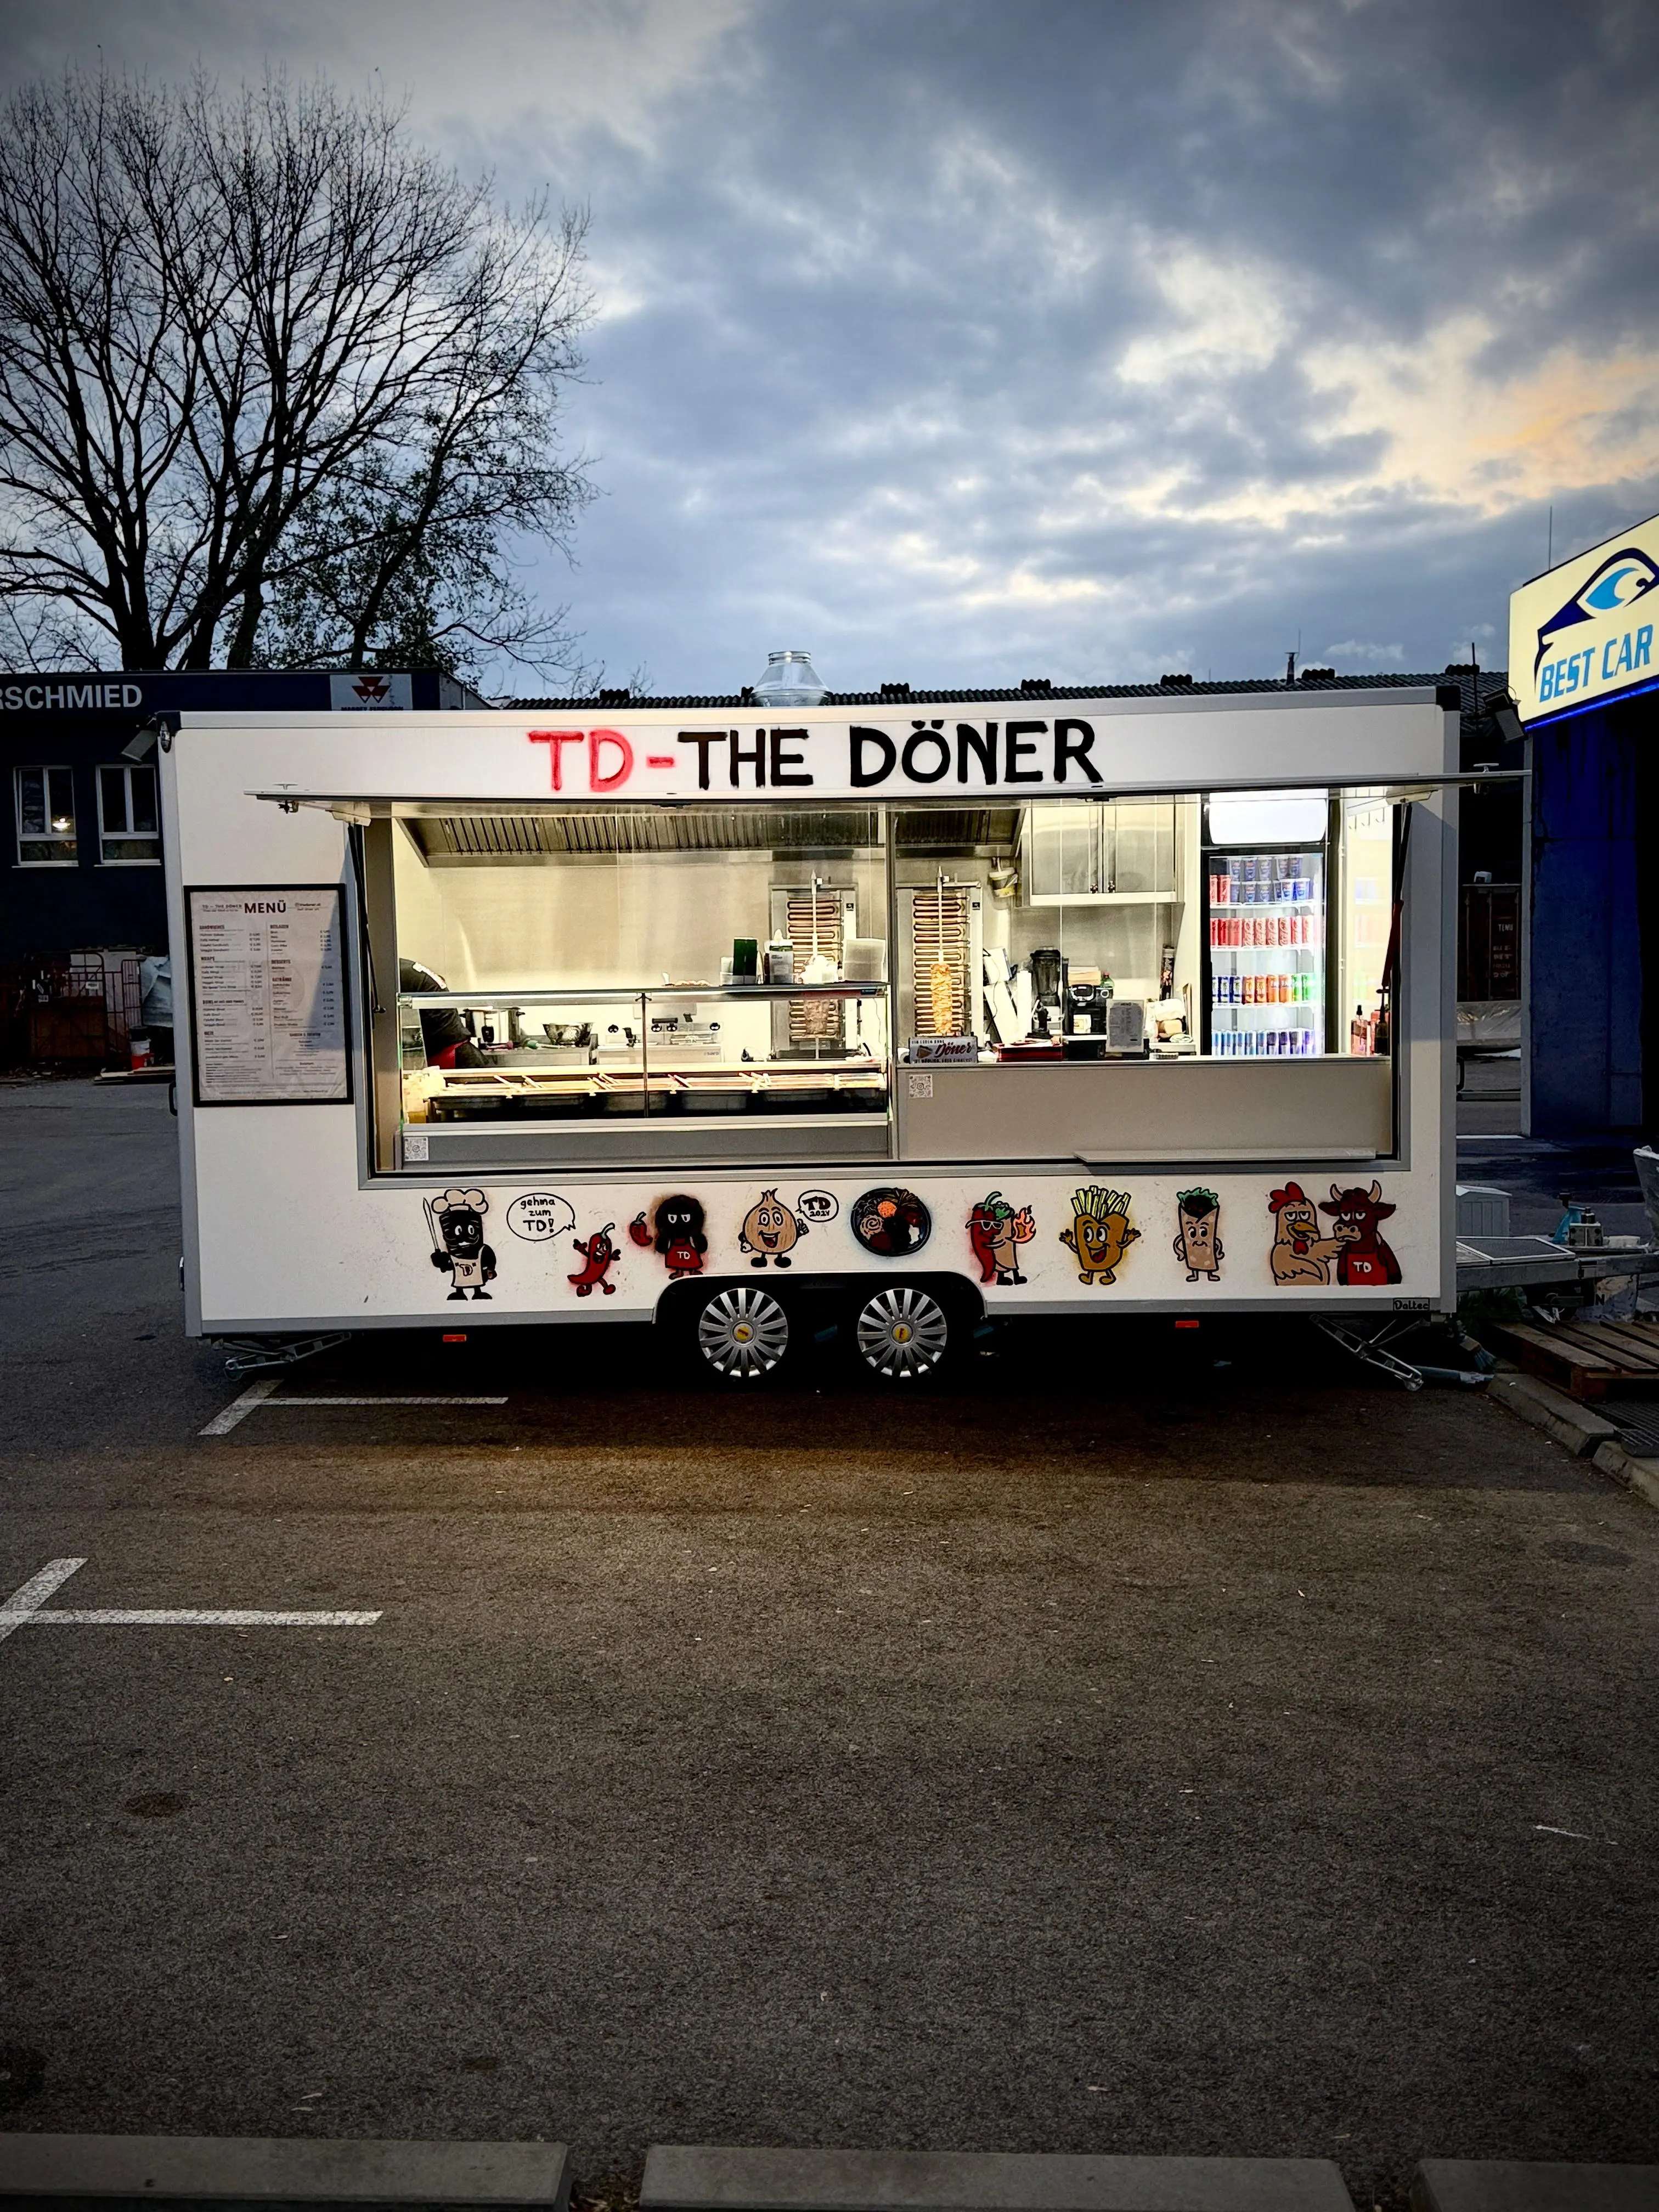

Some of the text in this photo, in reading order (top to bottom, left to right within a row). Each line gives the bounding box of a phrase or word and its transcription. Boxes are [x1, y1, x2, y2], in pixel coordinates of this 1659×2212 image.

[1539, 624, 1654, 703] BEST CAR
[0, 685, 143, 710] SCHMIED
[849, 719, 1103, 787] DÖNER
[244, 900, 286, 913] MENÜ
[521, 1196, 556, 1210] gehma
[802, 1195, 831, 1210] TD
[523, 1218, 555, 1233] TD!
[677, 1251, 691, 1260] TD
[1353, 1261, 1372, 1273] TD
[1394, 1299, 1429, 1311] Daltec
